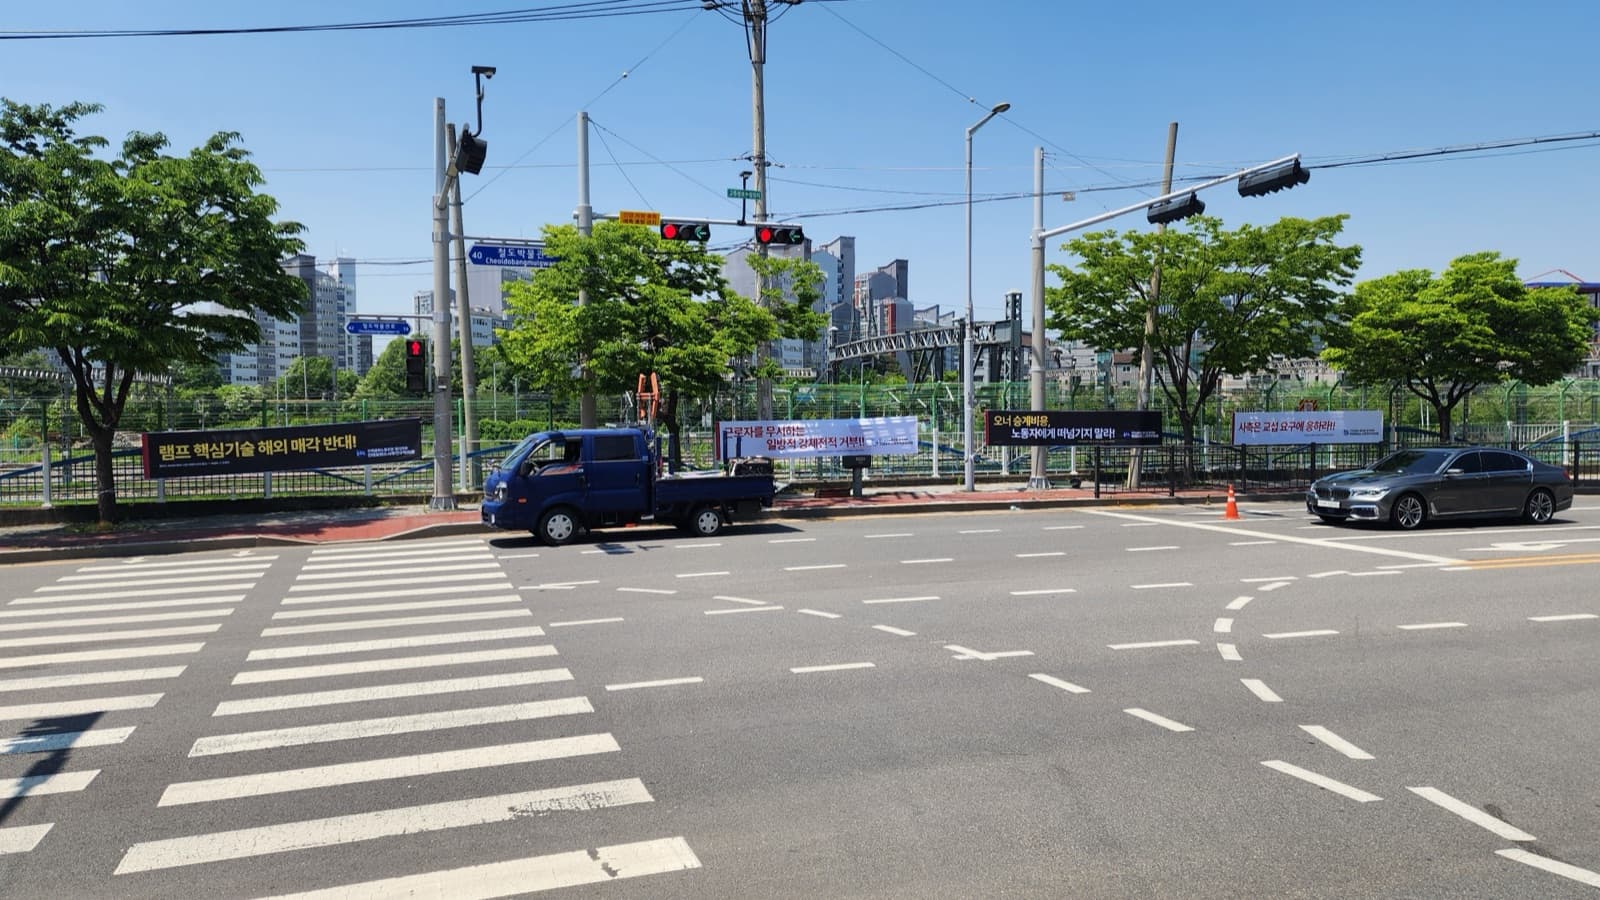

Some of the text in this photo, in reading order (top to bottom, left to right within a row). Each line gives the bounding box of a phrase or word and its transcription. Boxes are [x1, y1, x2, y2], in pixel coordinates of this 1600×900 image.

[472, 247, 545, 259] 40 철도박물관
[993, 415, 1051, 428] 오너 승계비용,
[1239, 421, 1261, 433] 사측은
[1263, 422, 1278, 432] 교섭
[1280, 421, 1304, 432] 요구에
[1305, 420, 1335, 432] 응하라!!
[725, 425, 763, 438] 근로자를
[1011, 427, 1056, 439] 노동자에게
[1057, 427, 1093, 439] 떠넘기지
[1094, 427, 1115, 439] 말라!
[158, 443, 192, 462] 램프
[193, 440, 255, 461] 핵심기술
[257, 438, 288, 456] 해외
[291, 436, 320, 453] 매각
[323, 434, 357, 452] 반대!
[766, 437, 797, 451] 일방적
[799, 436, 838, 449] 강제전적
[839, 436, 865, 449] 거부!!
